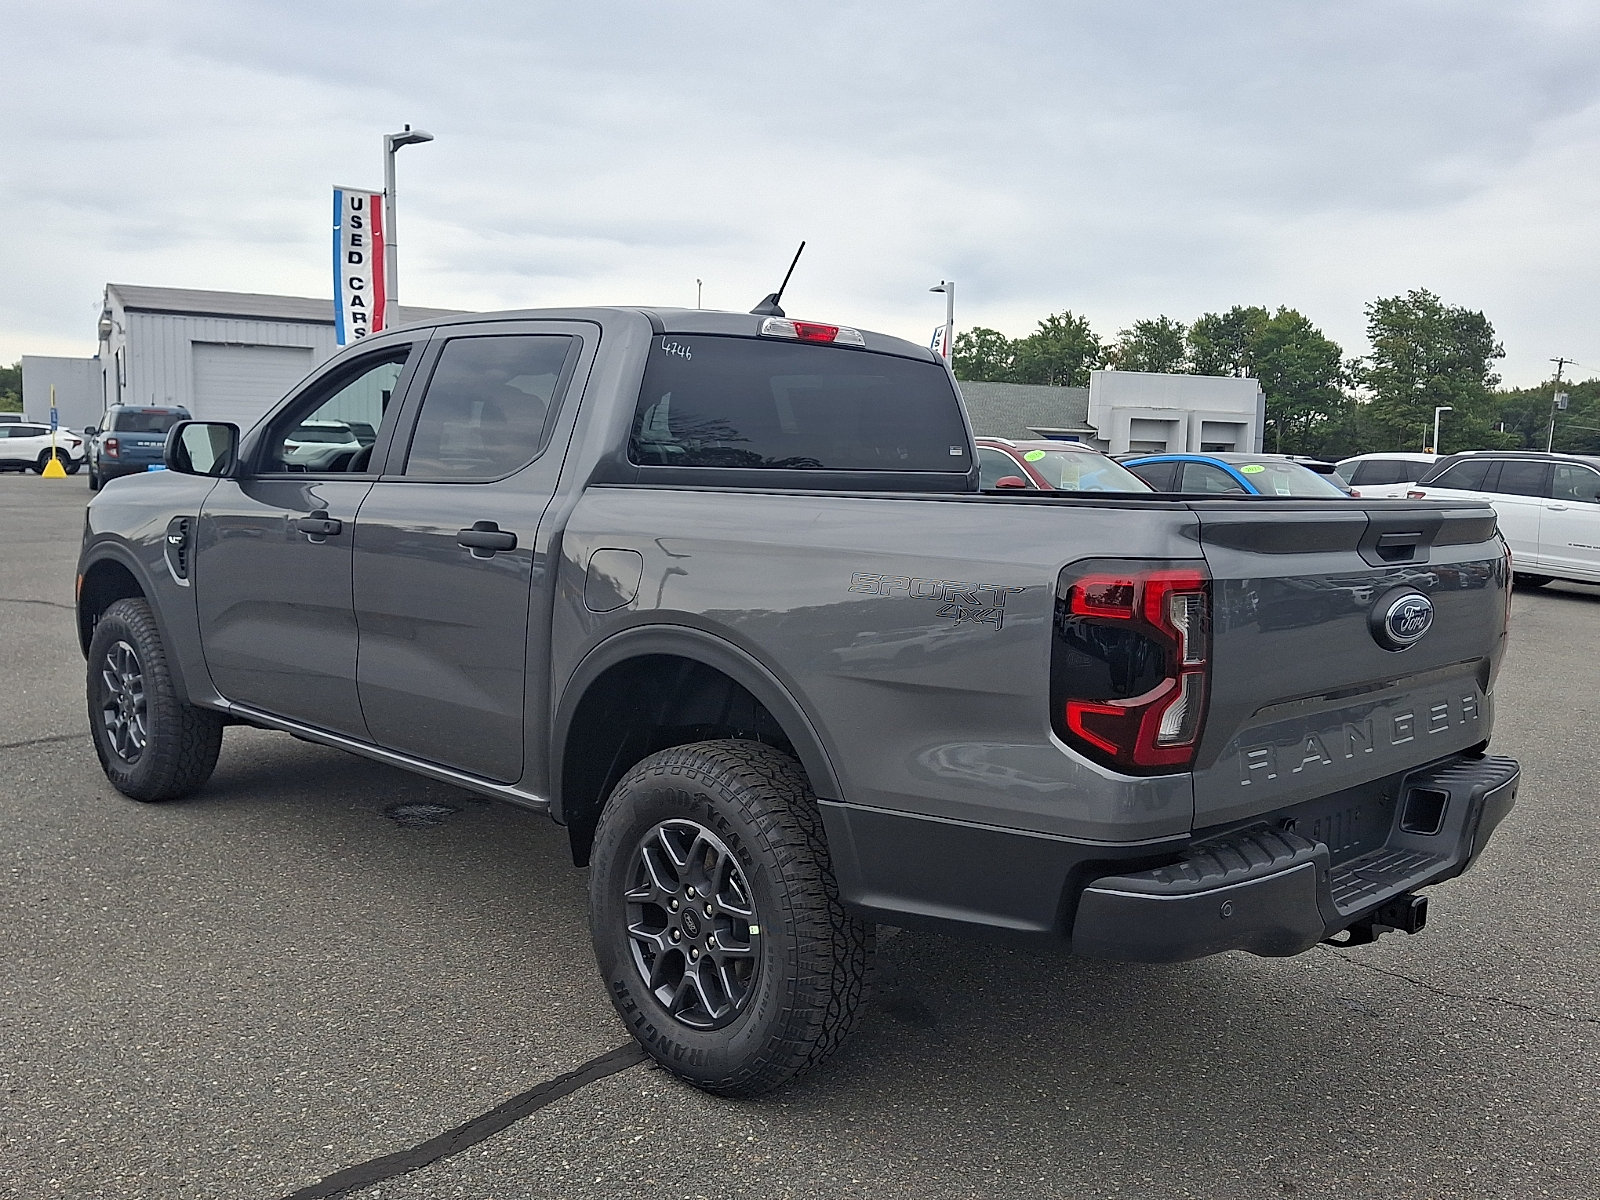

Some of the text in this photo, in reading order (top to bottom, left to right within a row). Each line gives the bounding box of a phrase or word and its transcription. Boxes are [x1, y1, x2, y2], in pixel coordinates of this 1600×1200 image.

[348, 196, 367, 340] USED CARS
[660, 335, 692, 361] 4746
[848, 571, 1026, 608] SPORT
[1400, 605, 1427, 632] Ford
[1239, 691, 1479, 786] RANGER
